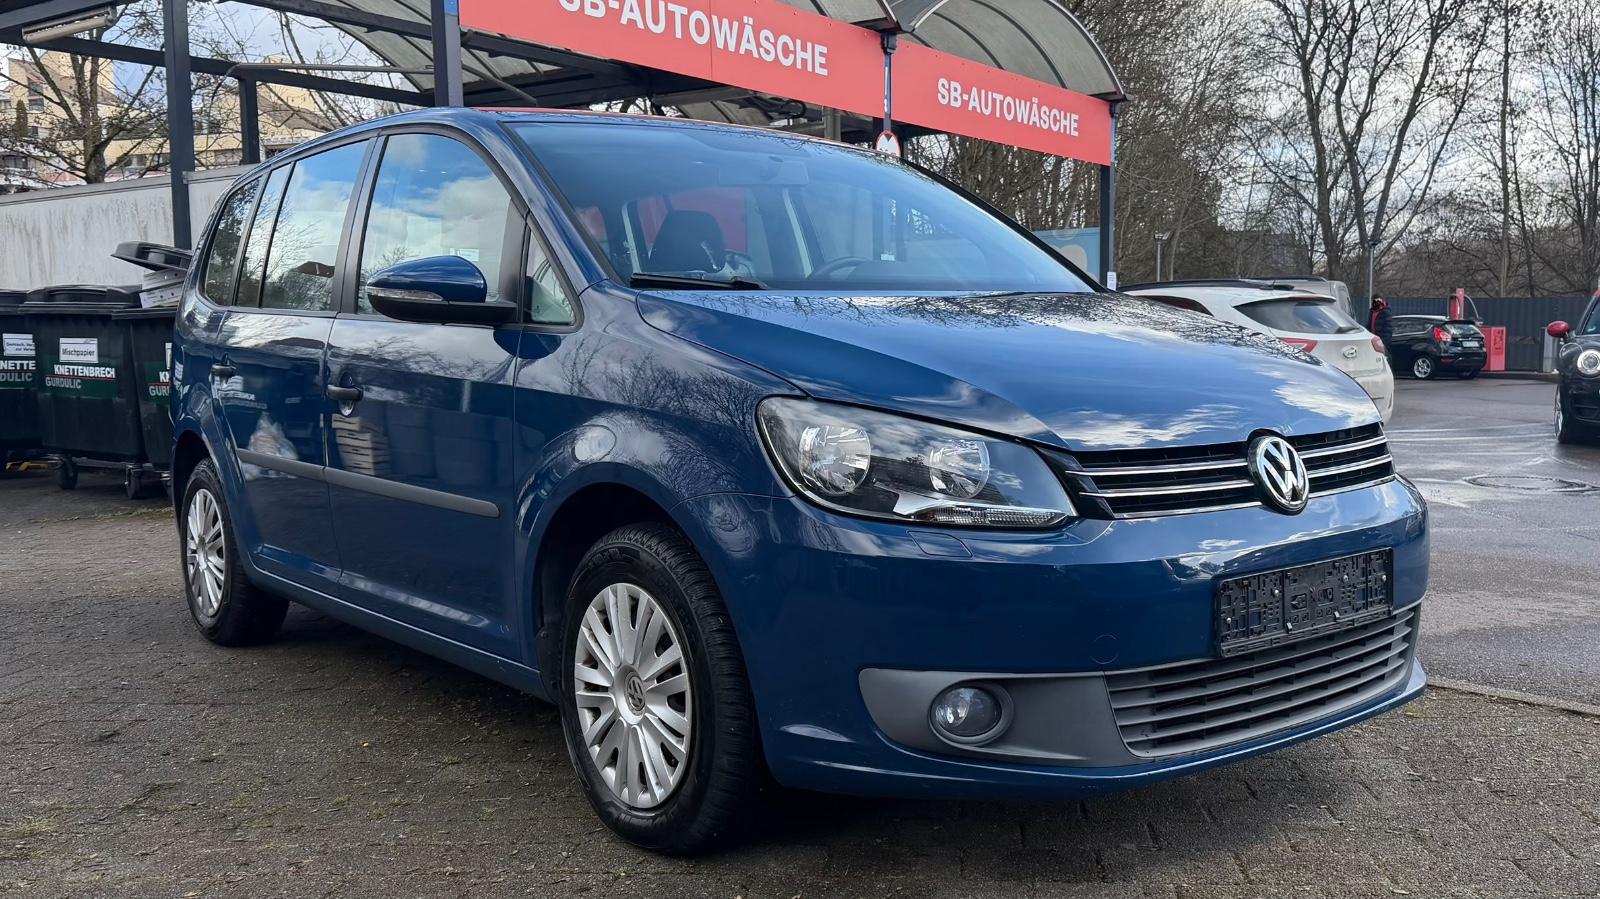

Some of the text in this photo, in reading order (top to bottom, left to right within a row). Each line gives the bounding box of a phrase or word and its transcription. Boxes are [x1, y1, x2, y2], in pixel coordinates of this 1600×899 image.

[559, 0, 828, 76] -AUTOWÄSCHE
[937, 78, 1079, 137] SB-AUTOWÄSCHE
[45, 377, 81, 388] GURDULIC
[54, 365, 115, 378] KNETTENBRECH
